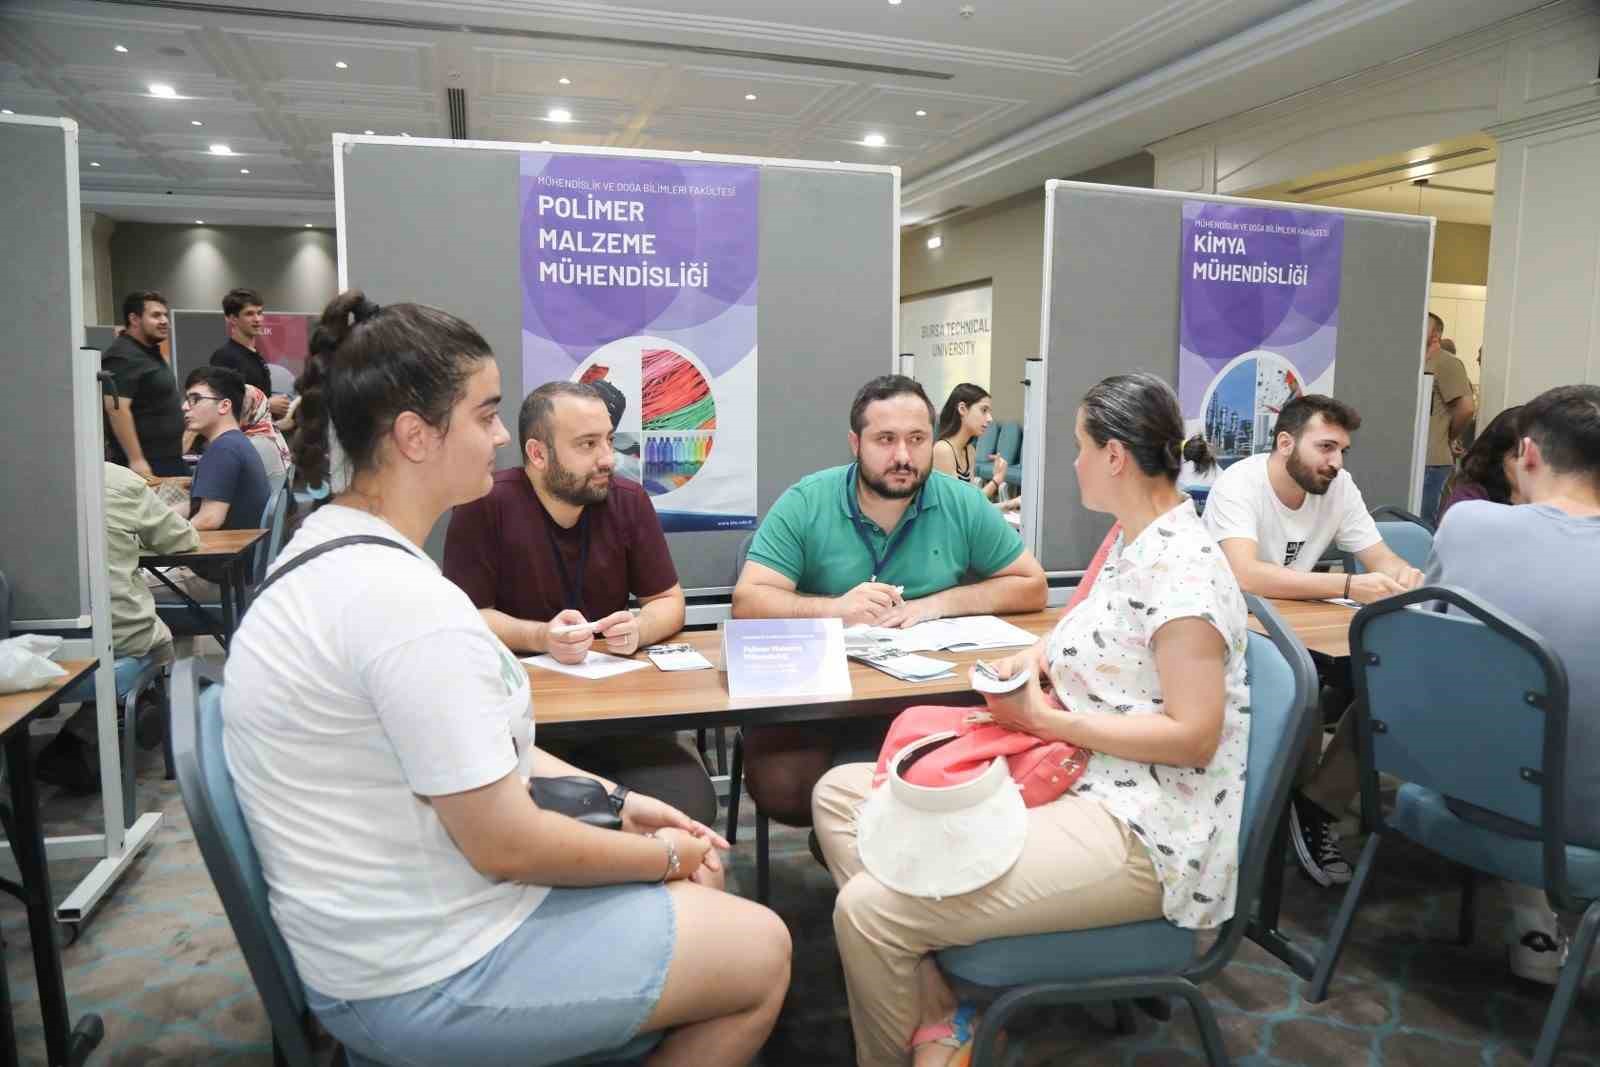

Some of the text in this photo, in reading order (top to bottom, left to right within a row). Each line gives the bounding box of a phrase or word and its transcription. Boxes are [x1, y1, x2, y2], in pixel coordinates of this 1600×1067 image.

[602, 182, 616, 192] VE
[538, 193, 645, 222] POLİMER
[539, 228, 657, 254] MALZEME
[1194, 231, 1247, 255] KİMYA
[539, 257, 709, 288] MÜHENDİSLİĞİ
[1193, 258, 1309, 286] MÜHENDİSLİĞİ
[945, 318, 991, 337] TECHNICAL
[932, 340, 976, 357] UNIVERSITY
